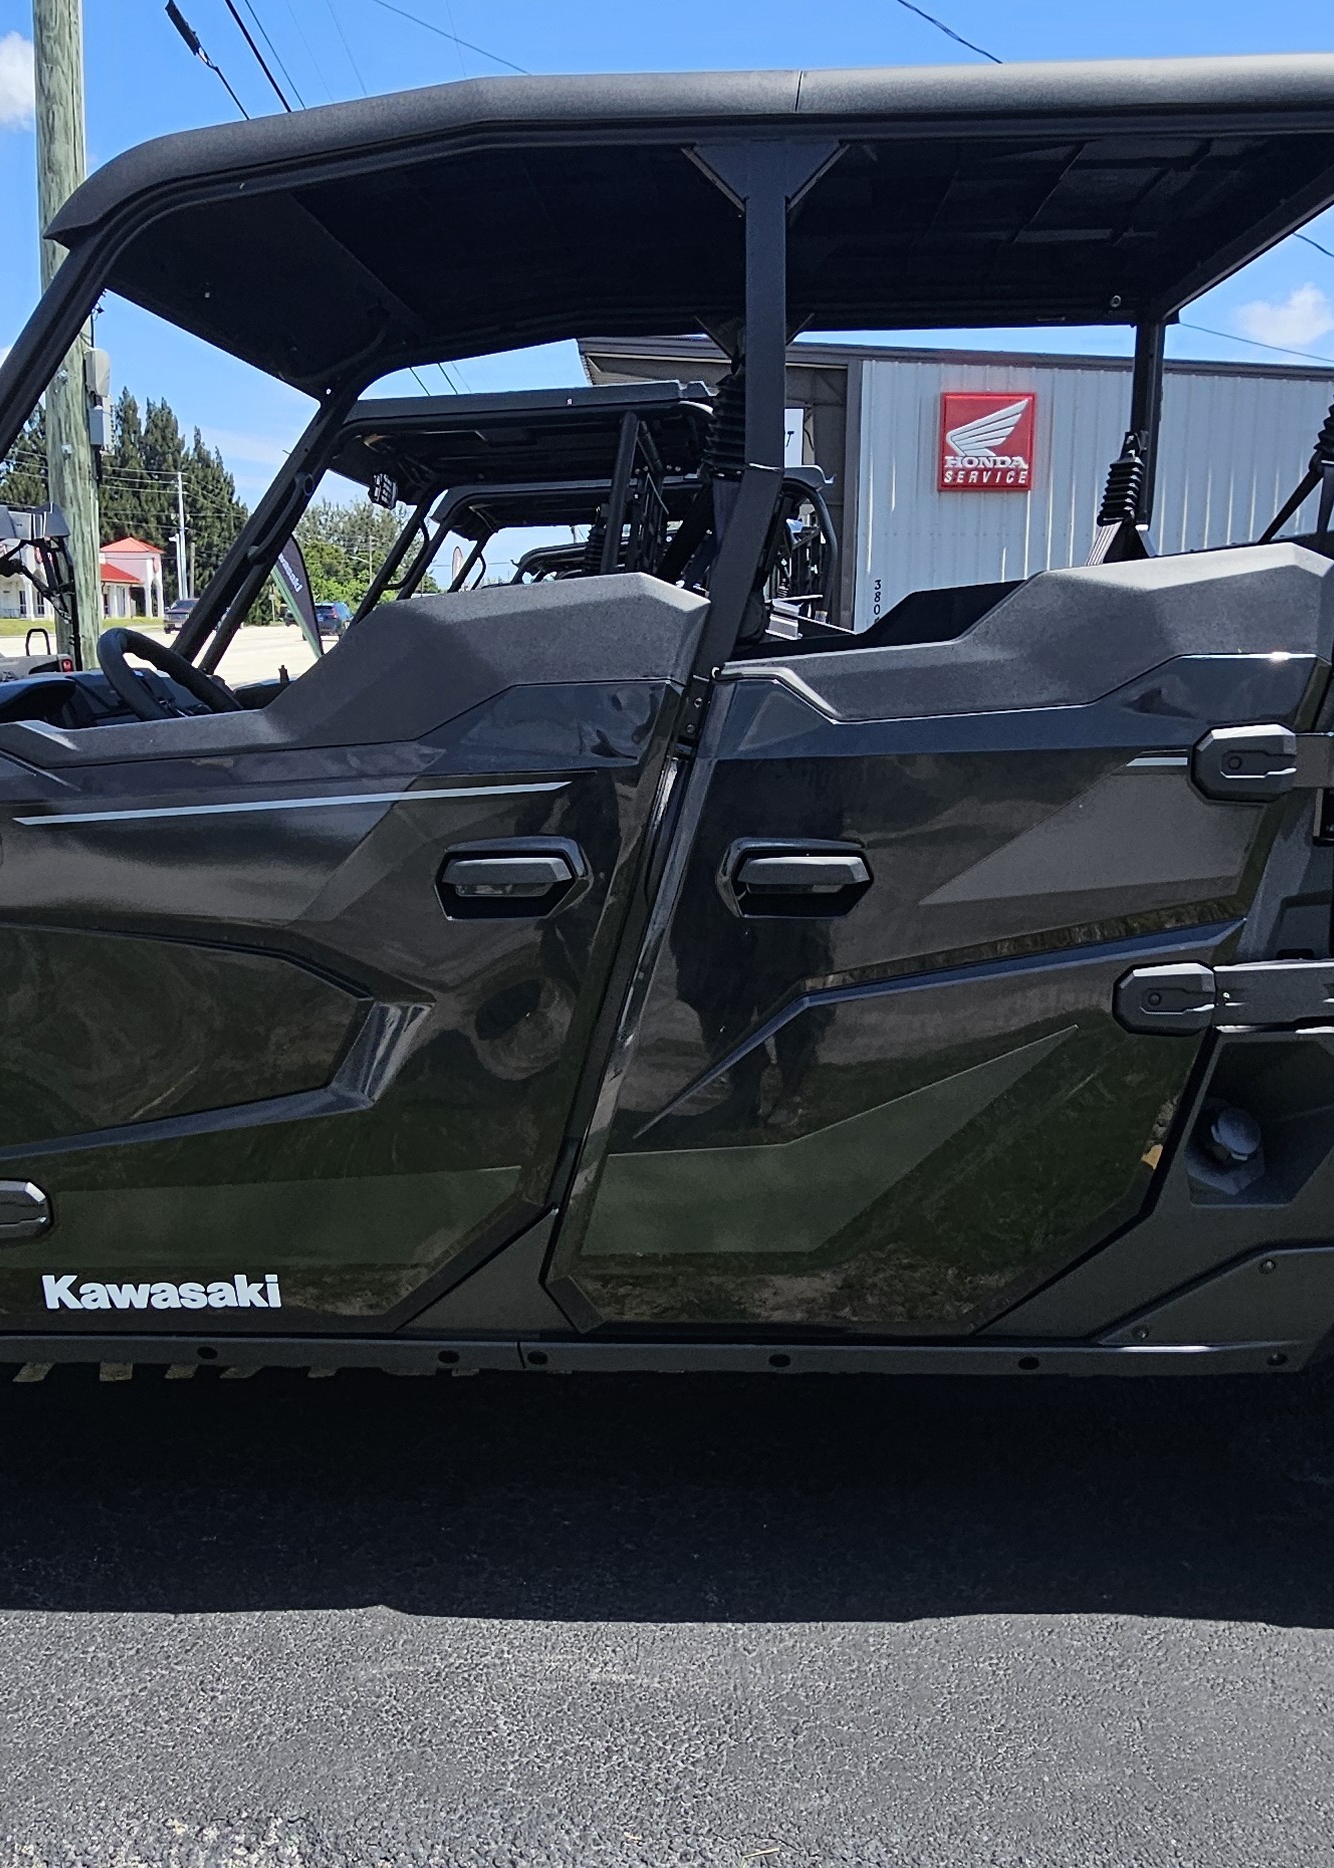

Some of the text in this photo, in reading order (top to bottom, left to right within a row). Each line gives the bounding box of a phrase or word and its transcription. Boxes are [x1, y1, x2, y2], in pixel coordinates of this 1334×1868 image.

[944, 456, 1029, 468] HONDA
[944, 470, 1028, 483] SERVICE
[278, 552, 303, 592] wasaki
[41, 1274, 282, 1310] Kawasaki
